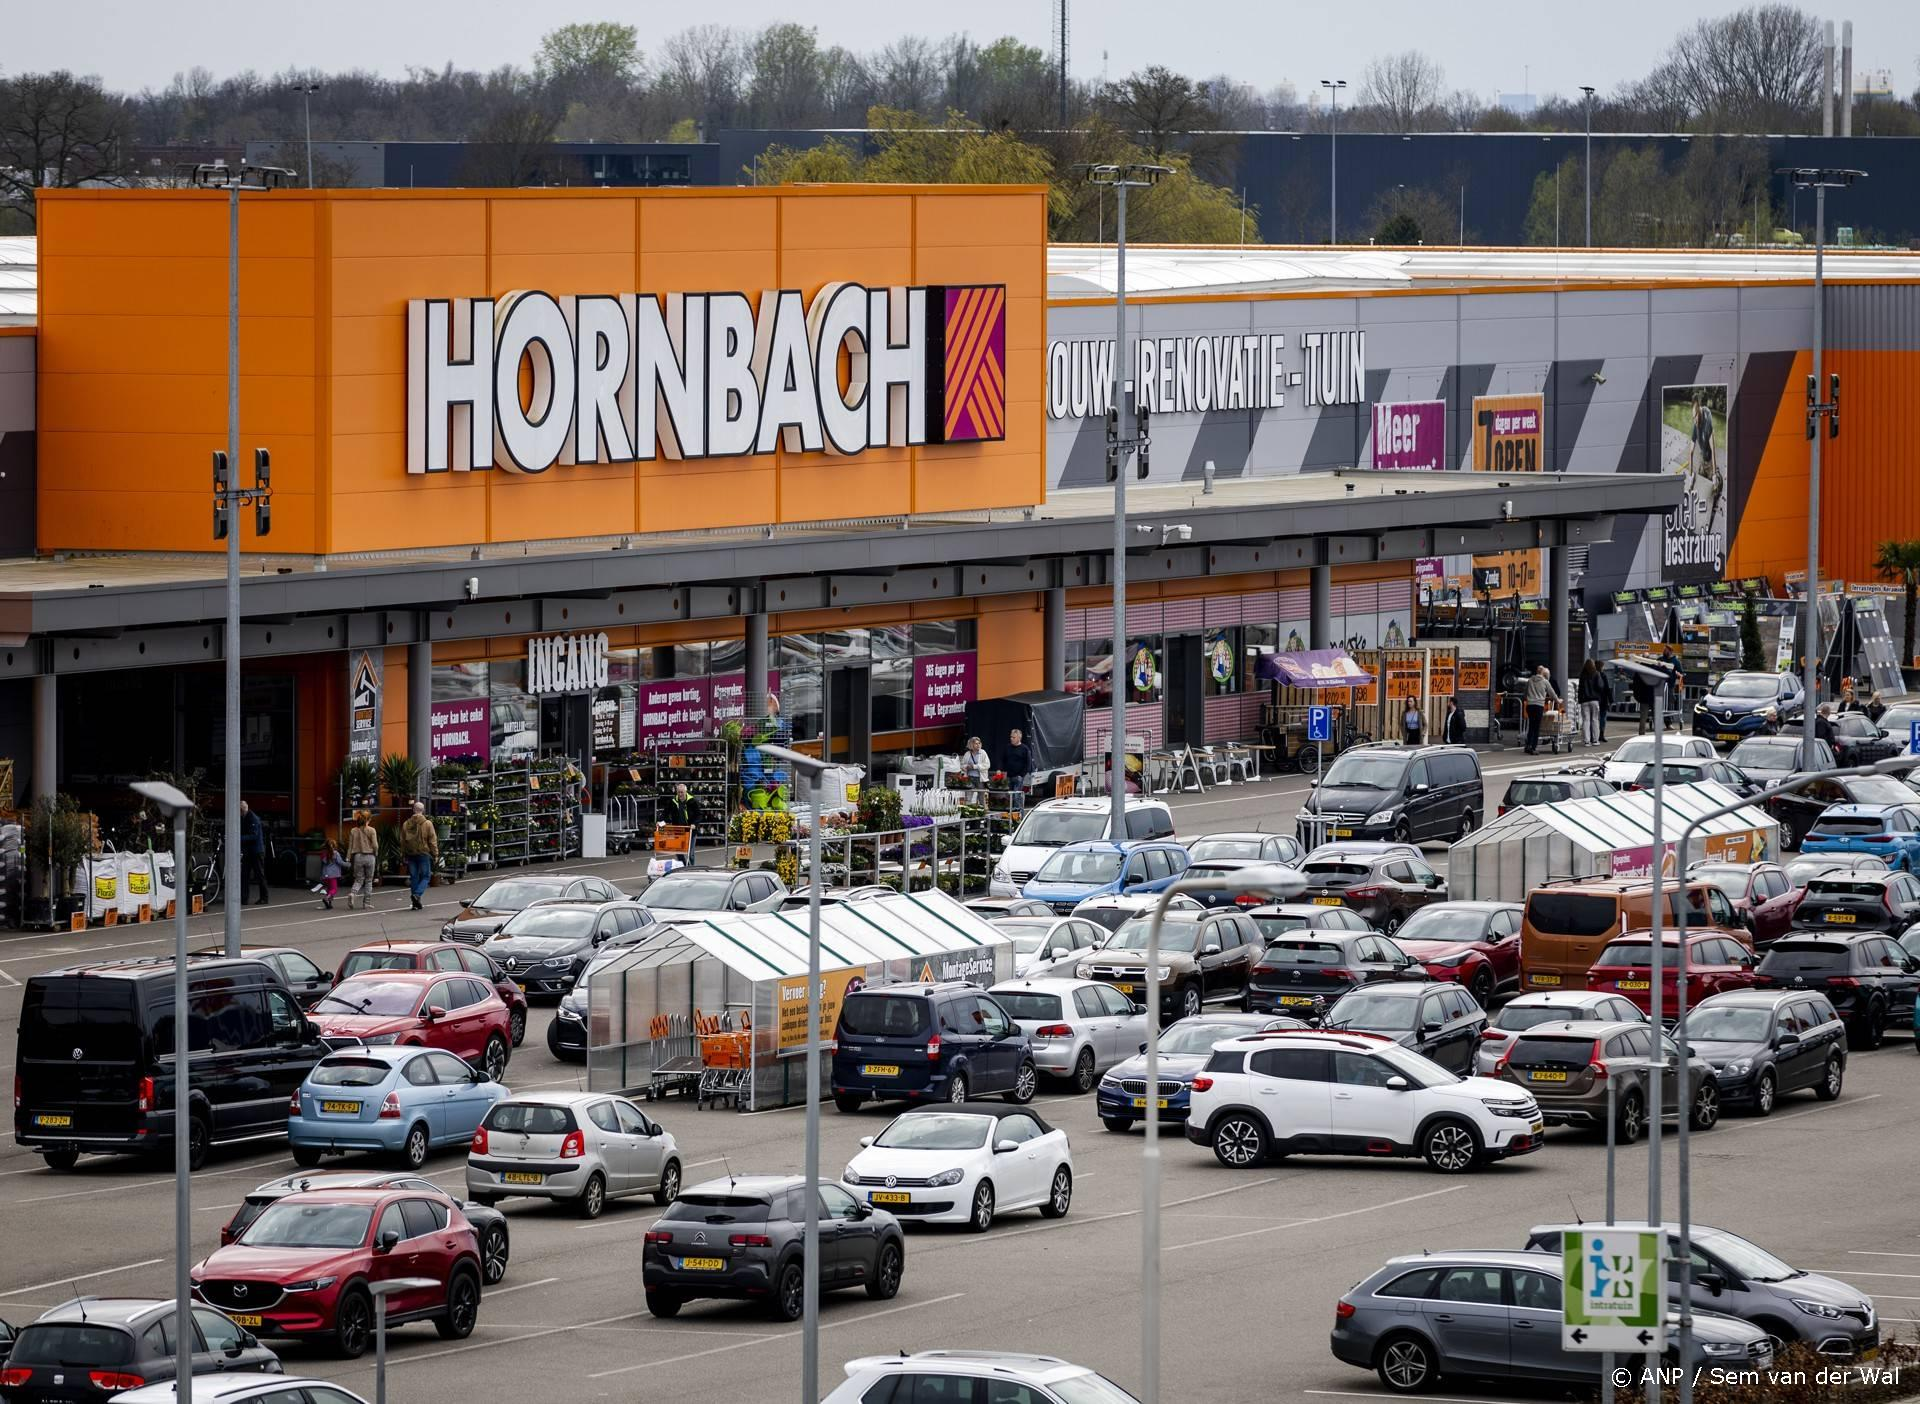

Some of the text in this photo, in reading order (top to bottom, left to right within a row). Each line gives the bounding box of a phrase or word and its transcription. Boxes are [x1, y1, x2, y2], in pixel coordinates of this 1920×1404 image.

[410, 282, 927, 474] HORNBACH
[1046, 340, 1117, 420] OUW
[1302, 330, 1366, 407] TUIN
[1377, 404, 1421, 455] Meer
[1495, 411, 1536, 434] dagen per week
[1495, 438, 1536, 472] OPEN
[1665, 527, 1722, 572] bestrating
[528, 632, 608, 694] INGANG
[1313, 709, 1324, 727] P
[941, 955, 992, 981] MontageService
[874, 1193, 906, 1202] JV-433-B
[1590, 1301, 1633, 1310] intratuin
